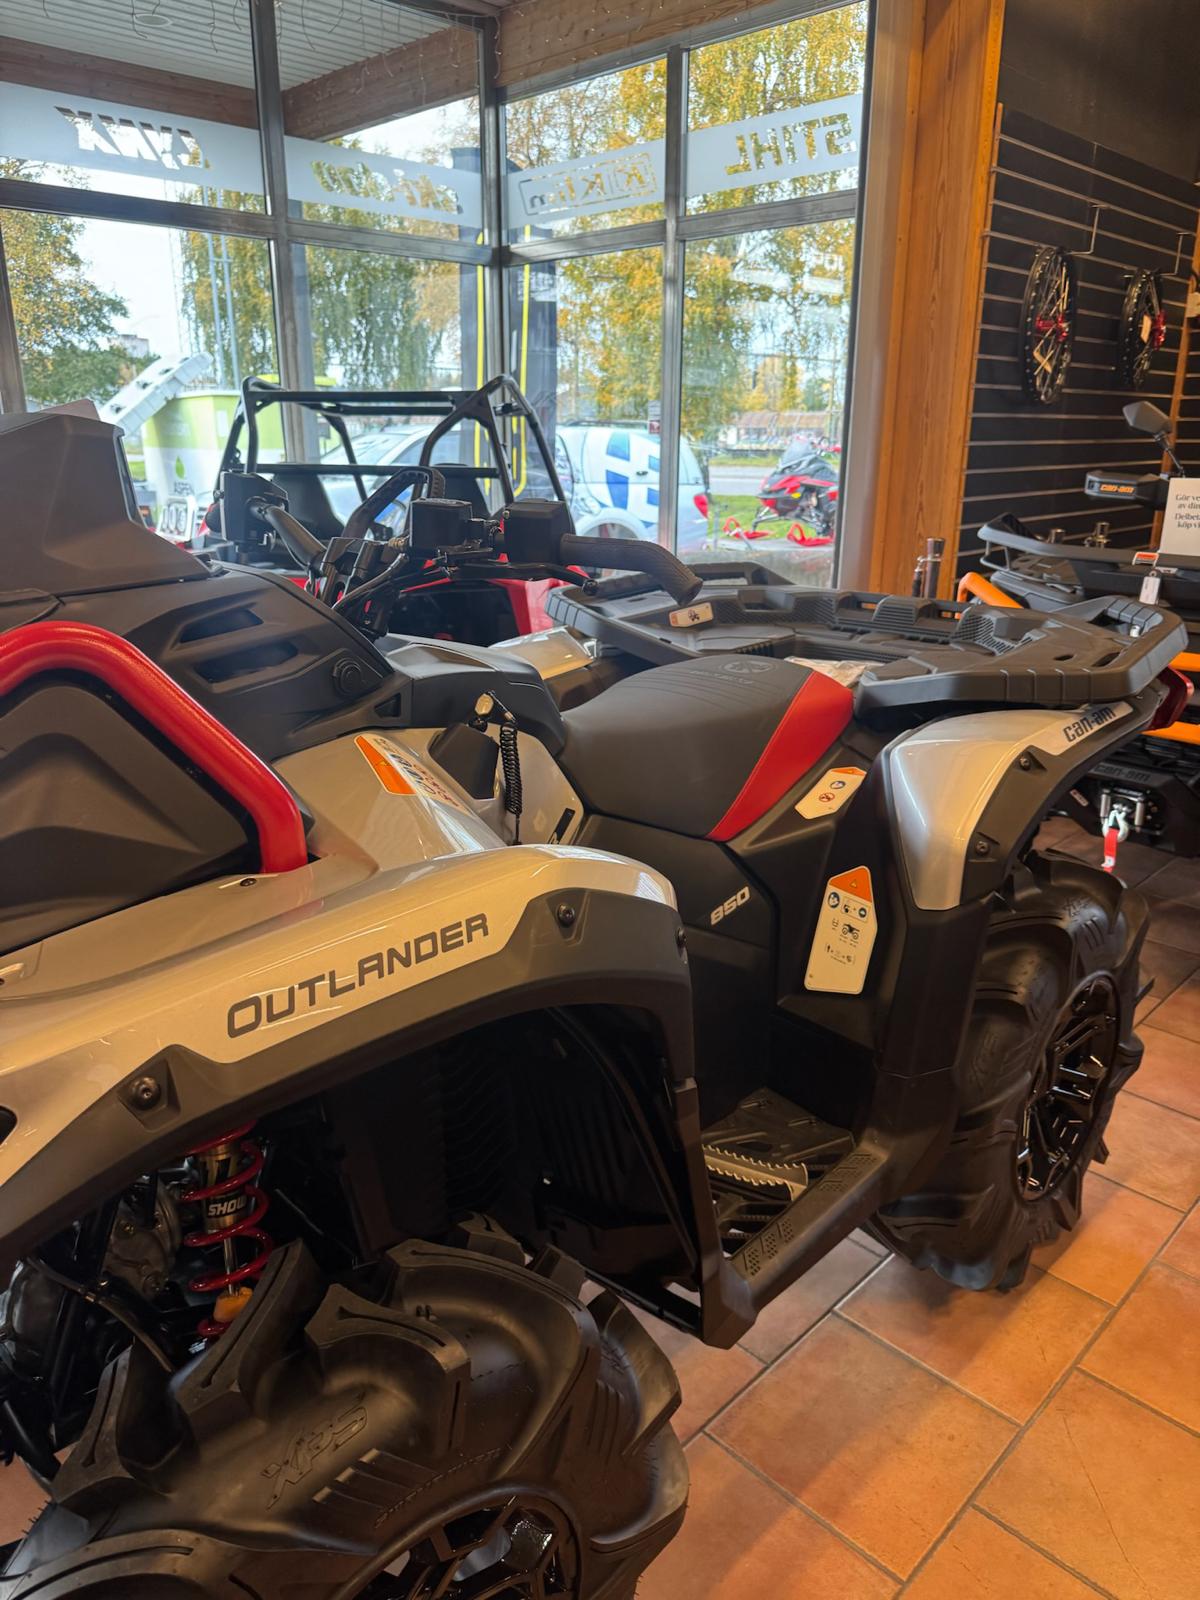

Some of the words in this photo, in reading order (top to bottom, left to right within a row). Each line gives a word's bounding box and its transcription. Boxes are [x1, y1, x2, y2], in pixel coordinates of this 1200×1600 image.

[1063, 706, 1117, 742] can-am
[710, 886, 751, 926] 850
[227, 913, 489, 1038] OUTLANDER
